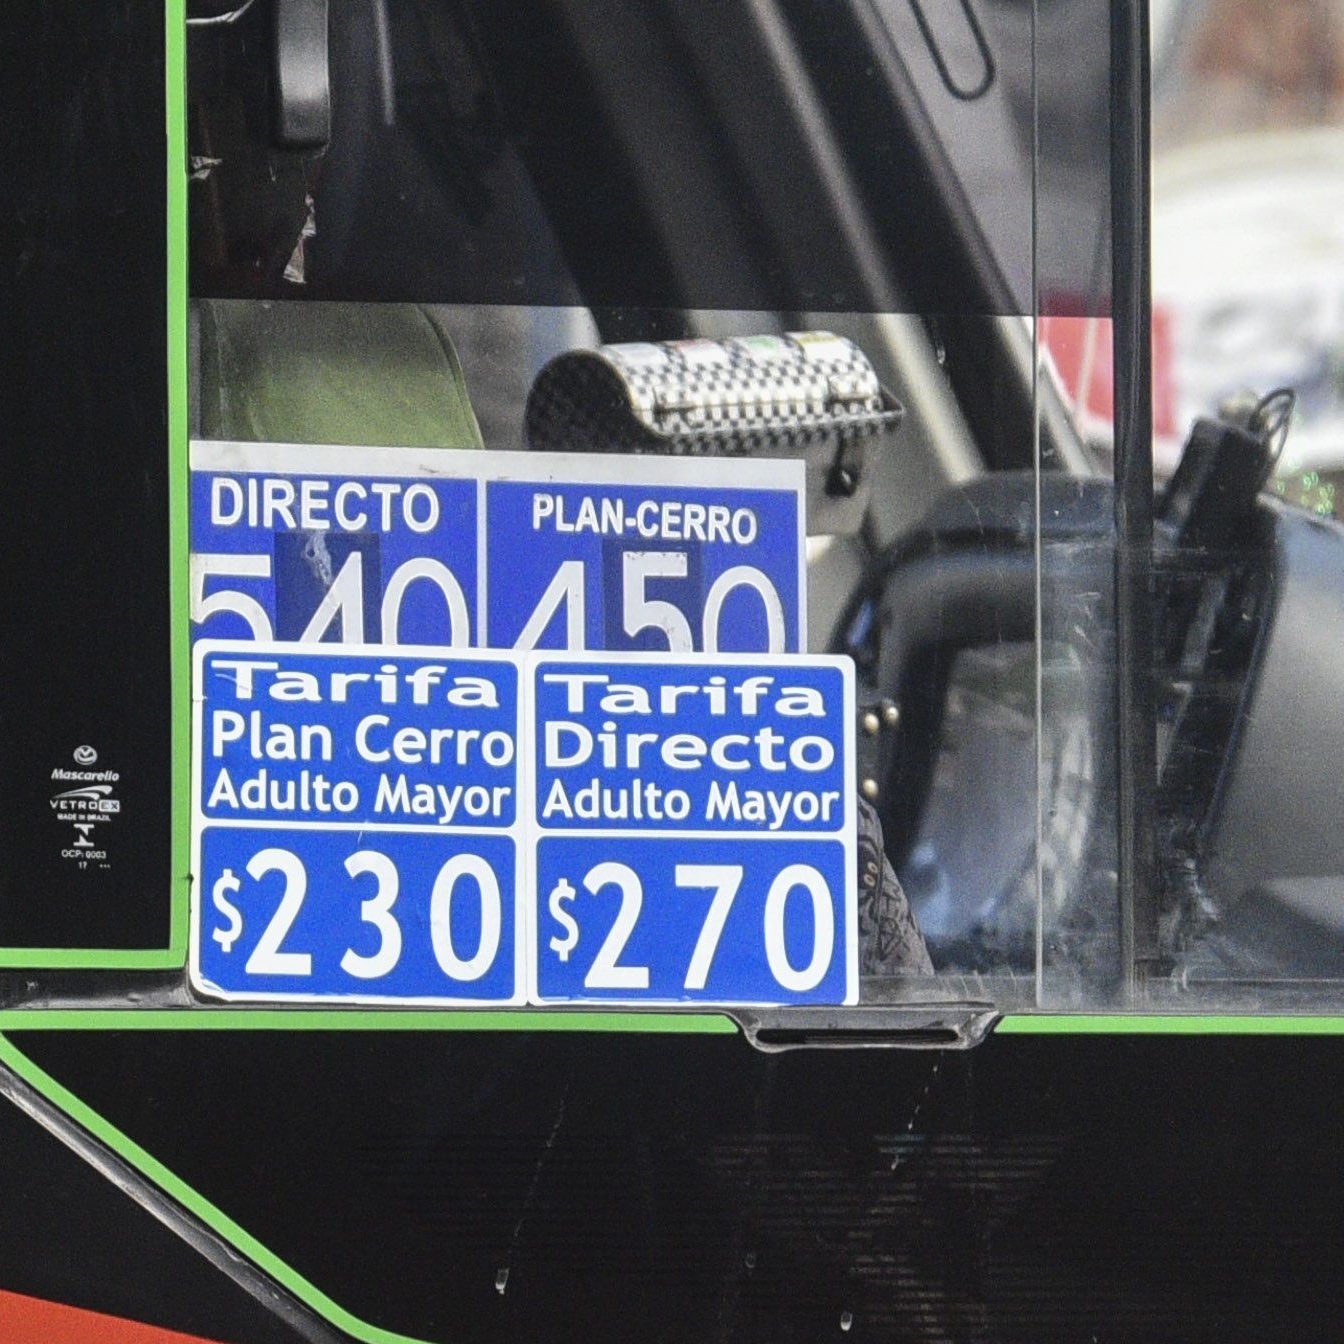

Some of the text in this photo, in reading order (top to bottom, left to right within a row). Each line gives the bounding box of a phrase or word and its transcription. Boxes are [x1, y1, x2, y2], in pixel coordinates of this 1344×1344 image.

[211, 478, 440, 532] DIRECTO
[531, 492, 757, 544] PLAN-CERRO
[213, 660, 500, 708] Tarifa
[544, 673, 827, 718] Tarifa
[213, 711, 515, 768] Plan Cerro
[545, 719, 835, 772] Directo
[51, 768, 119, 782] Mascarello
[208, 767, 512, 822] Adulto Mayor
[57, 813, 77, 821] MADE
[542, 778, 840, 830] Adulto Mayor
[212, 848, 503, 983] $230
[548, 862, 835, 993] $270
